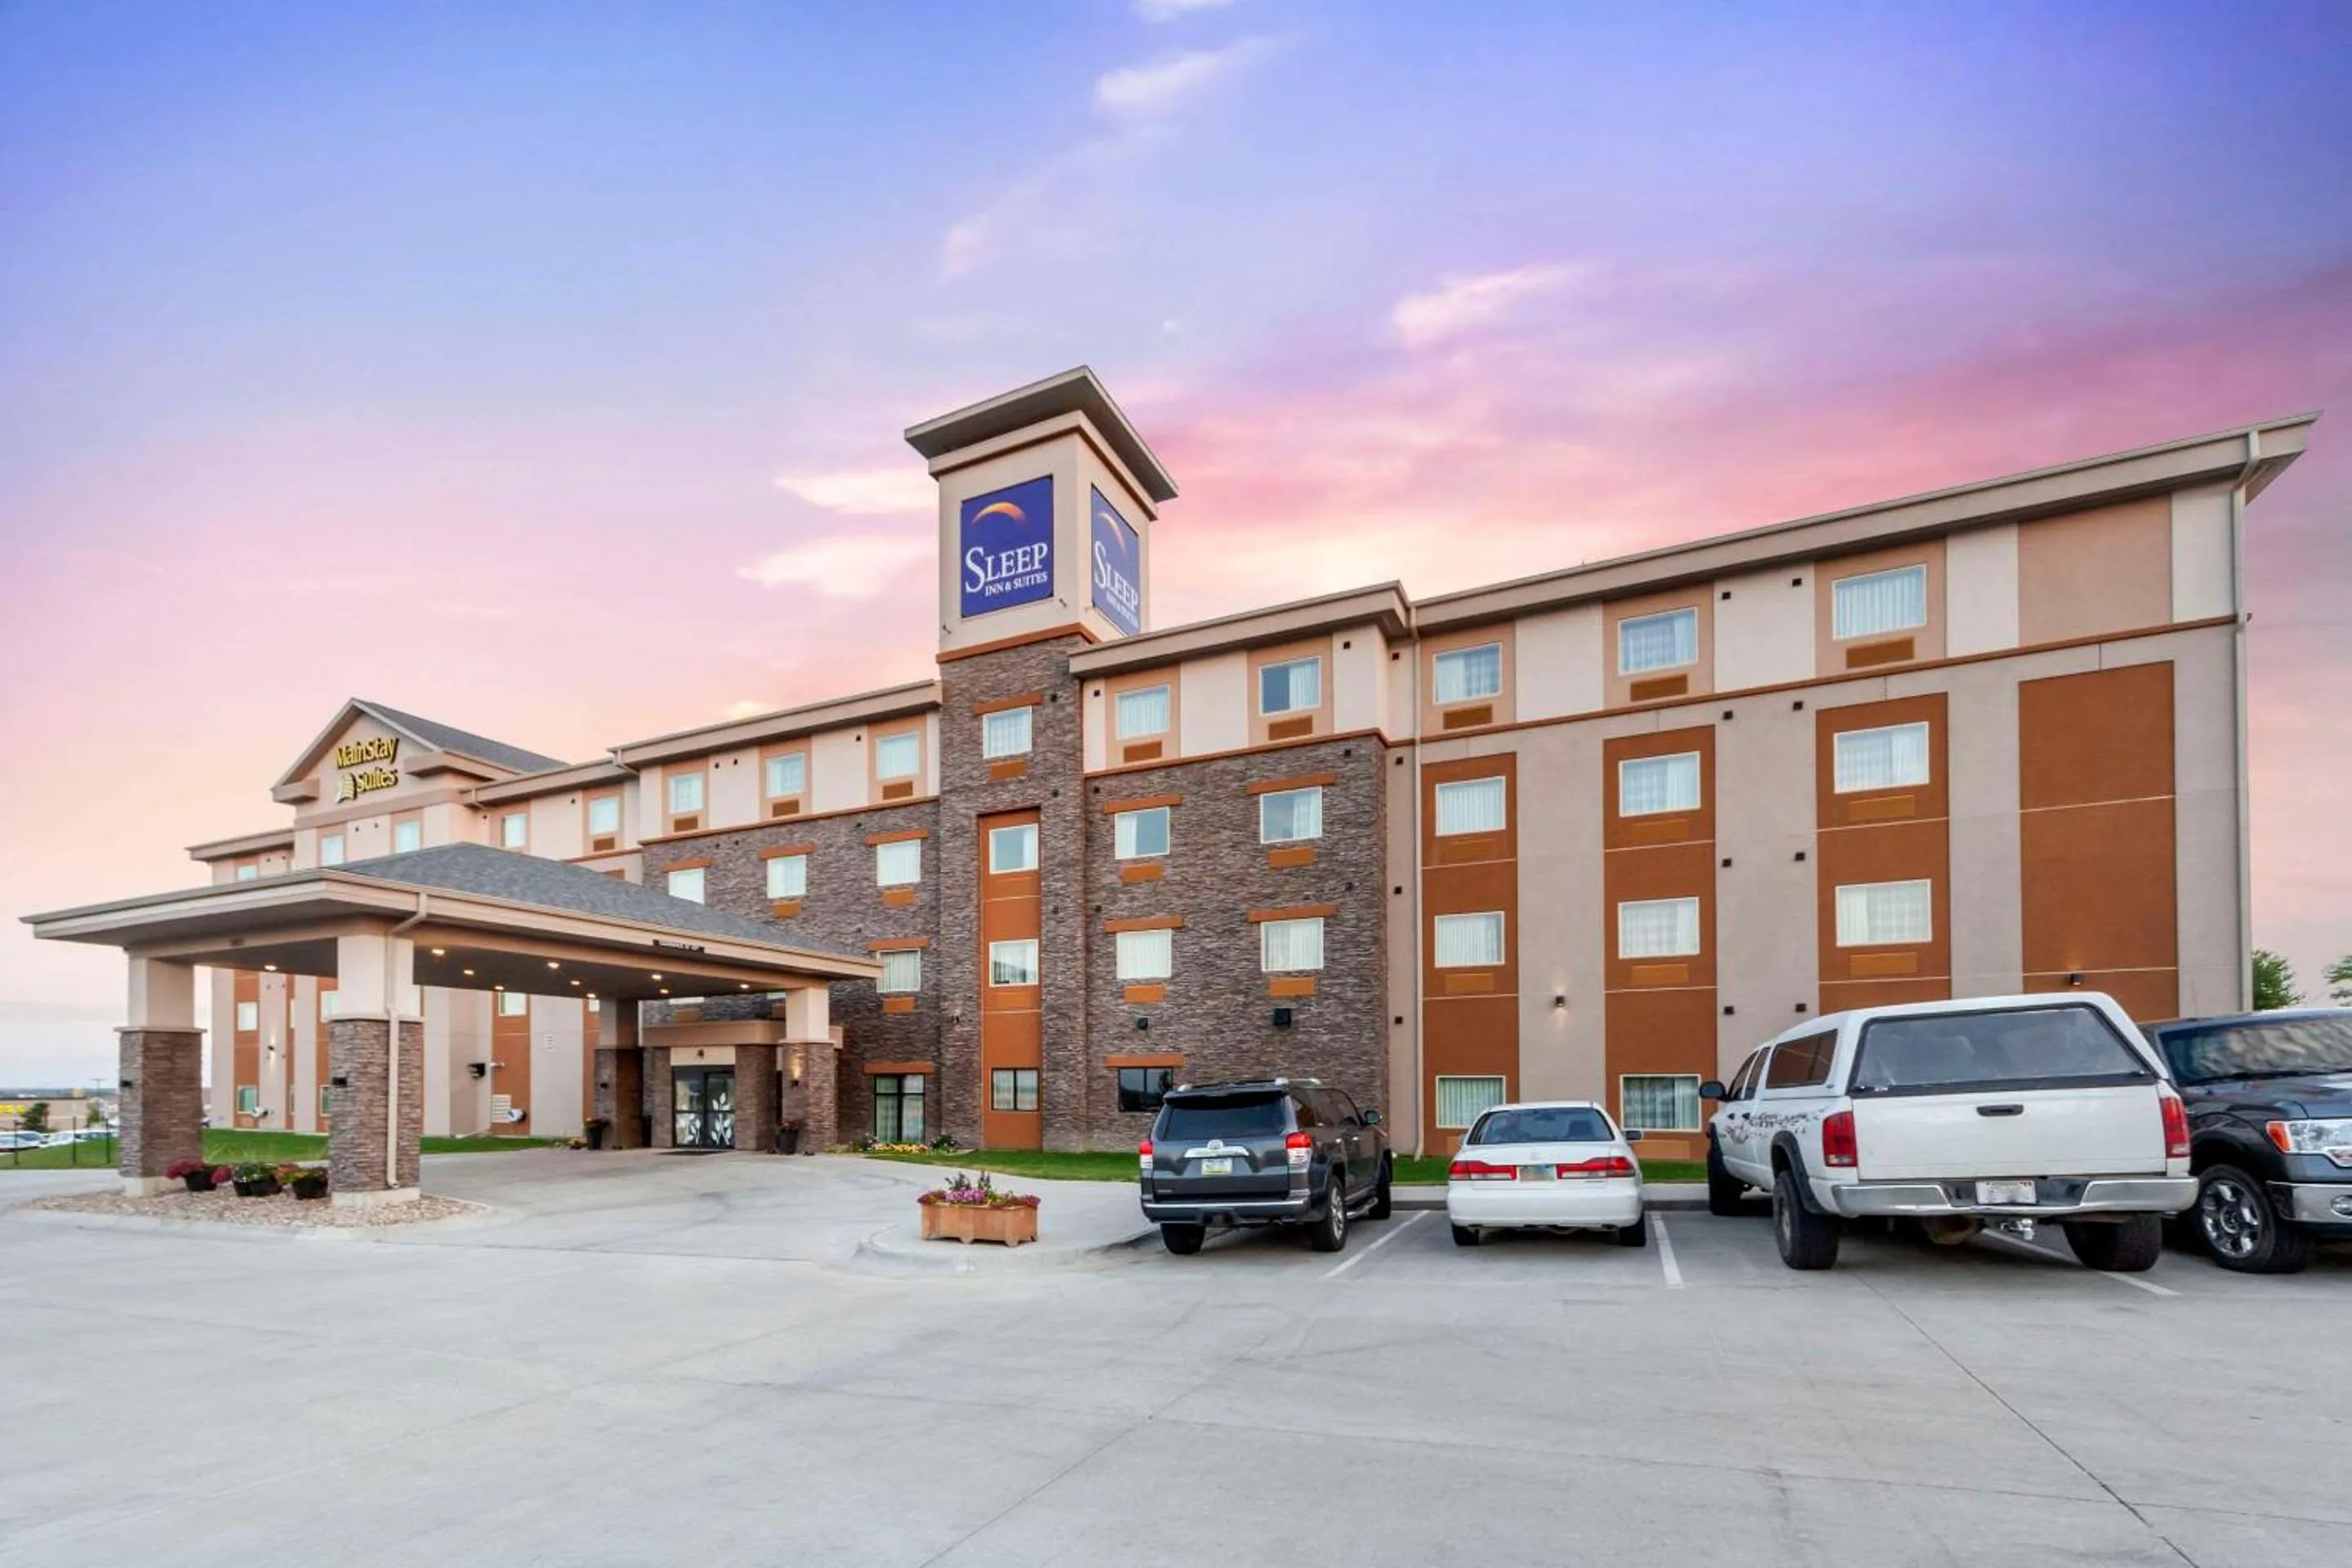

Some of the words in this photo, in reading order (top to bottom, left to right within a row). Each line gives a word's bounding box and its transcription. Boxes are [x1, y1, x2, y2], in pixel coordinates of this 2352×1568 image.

[965, 542, 1049, 594] SLEEP
[985, 581, 1004, 597] INN
[1004, 581, 1012, 591] &
[1012, 571, 1049, 590] SUITES
[336, 737, 399, 768] MainStay
[356, 768, 399, 794] Suites
